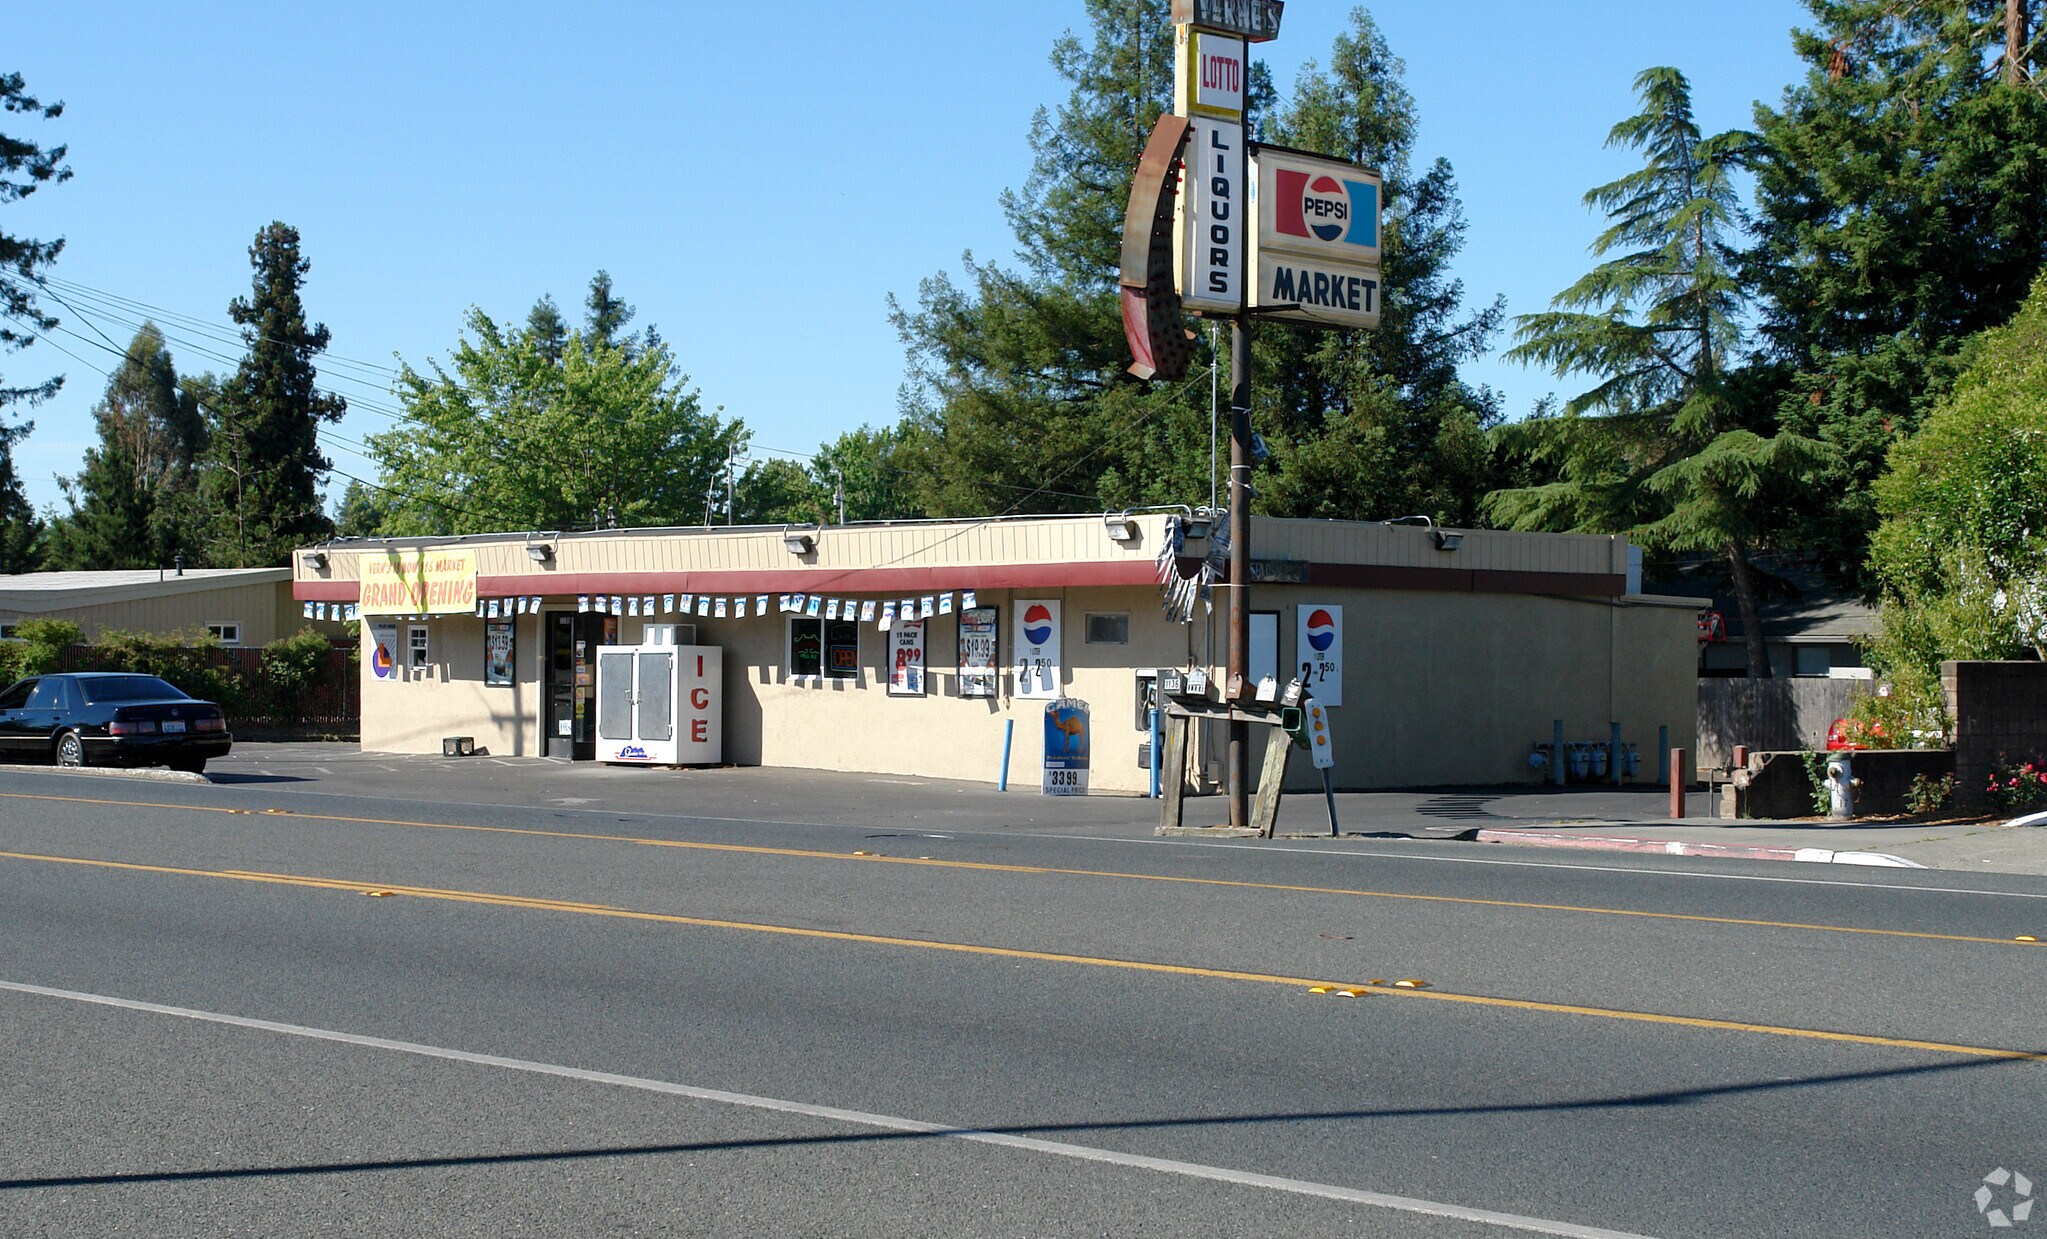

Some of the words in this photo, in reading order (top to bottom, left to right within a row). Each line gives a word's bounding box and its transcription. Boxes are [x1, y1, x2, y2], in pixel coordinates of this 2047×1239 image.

[1199, 0, 1278, 33] VERNE'S
[1202, 54, 1239, 93] LOTTO
[1209, 130, 1230, 294] LIQUORS
[1304, 196, 1348, 221] PEPSI
[1272, 266, 1377, 312] MARKET
[435, 559, 466, 573] MARKET
[362, 581, 407, 607] GRAND
[411, 579, 474, 607] OPENING
[834, 650, 858, 667] OPEN
[1019, 658, 1028, 683] 2
[1302, 662, 1312, 688] 2
[690, 654, 709, 743] ICE
[1045, 697, 1090, 714] CAMEL
[1045, 786, 1070, 794] SPECIAL
